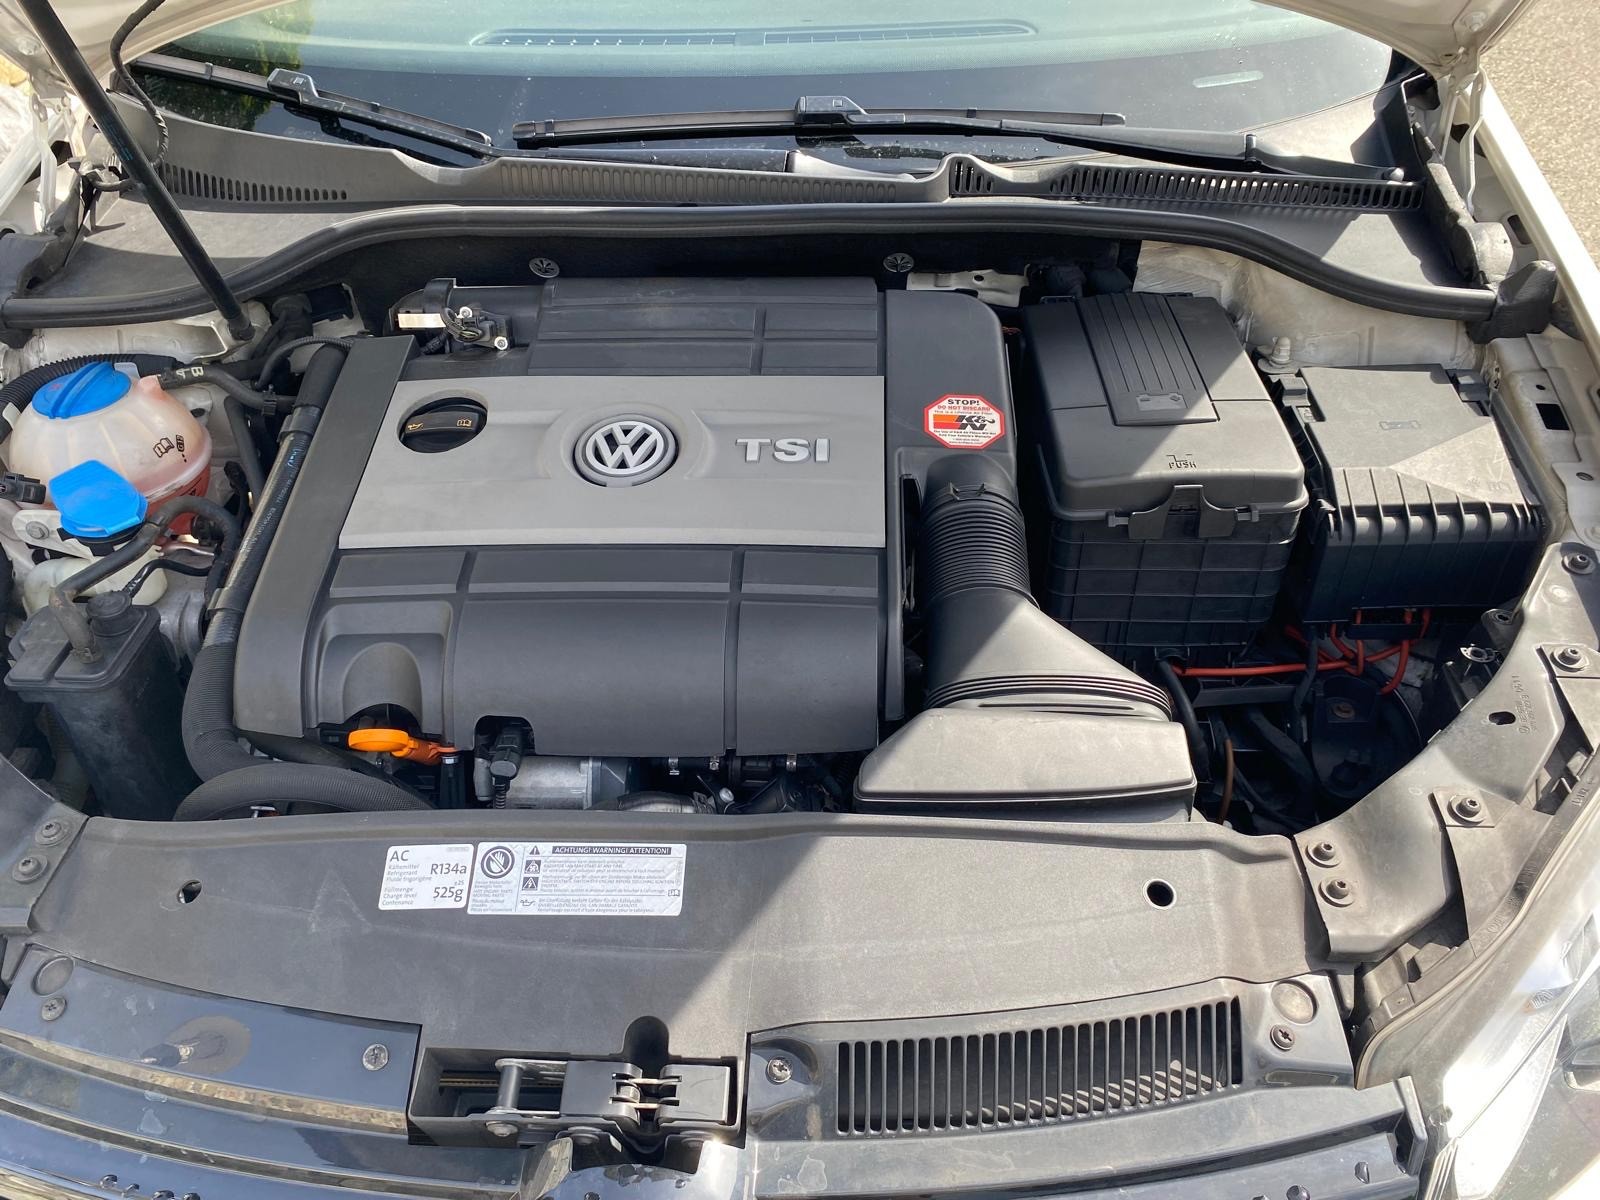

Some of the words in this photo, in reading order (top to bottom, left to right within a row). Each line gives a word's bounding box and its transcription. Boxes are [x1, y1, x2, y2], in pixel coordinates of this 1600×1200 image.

[735, 437, 831, 463] TSI
[1168, 460, 1197, 469] PUSH
[389, 850, 410, 862] AC
[629, 847, 669, 855] ATTENTION!
[430, 863, 467, 875] R134a
[433, 886, 464, 903] 525g
